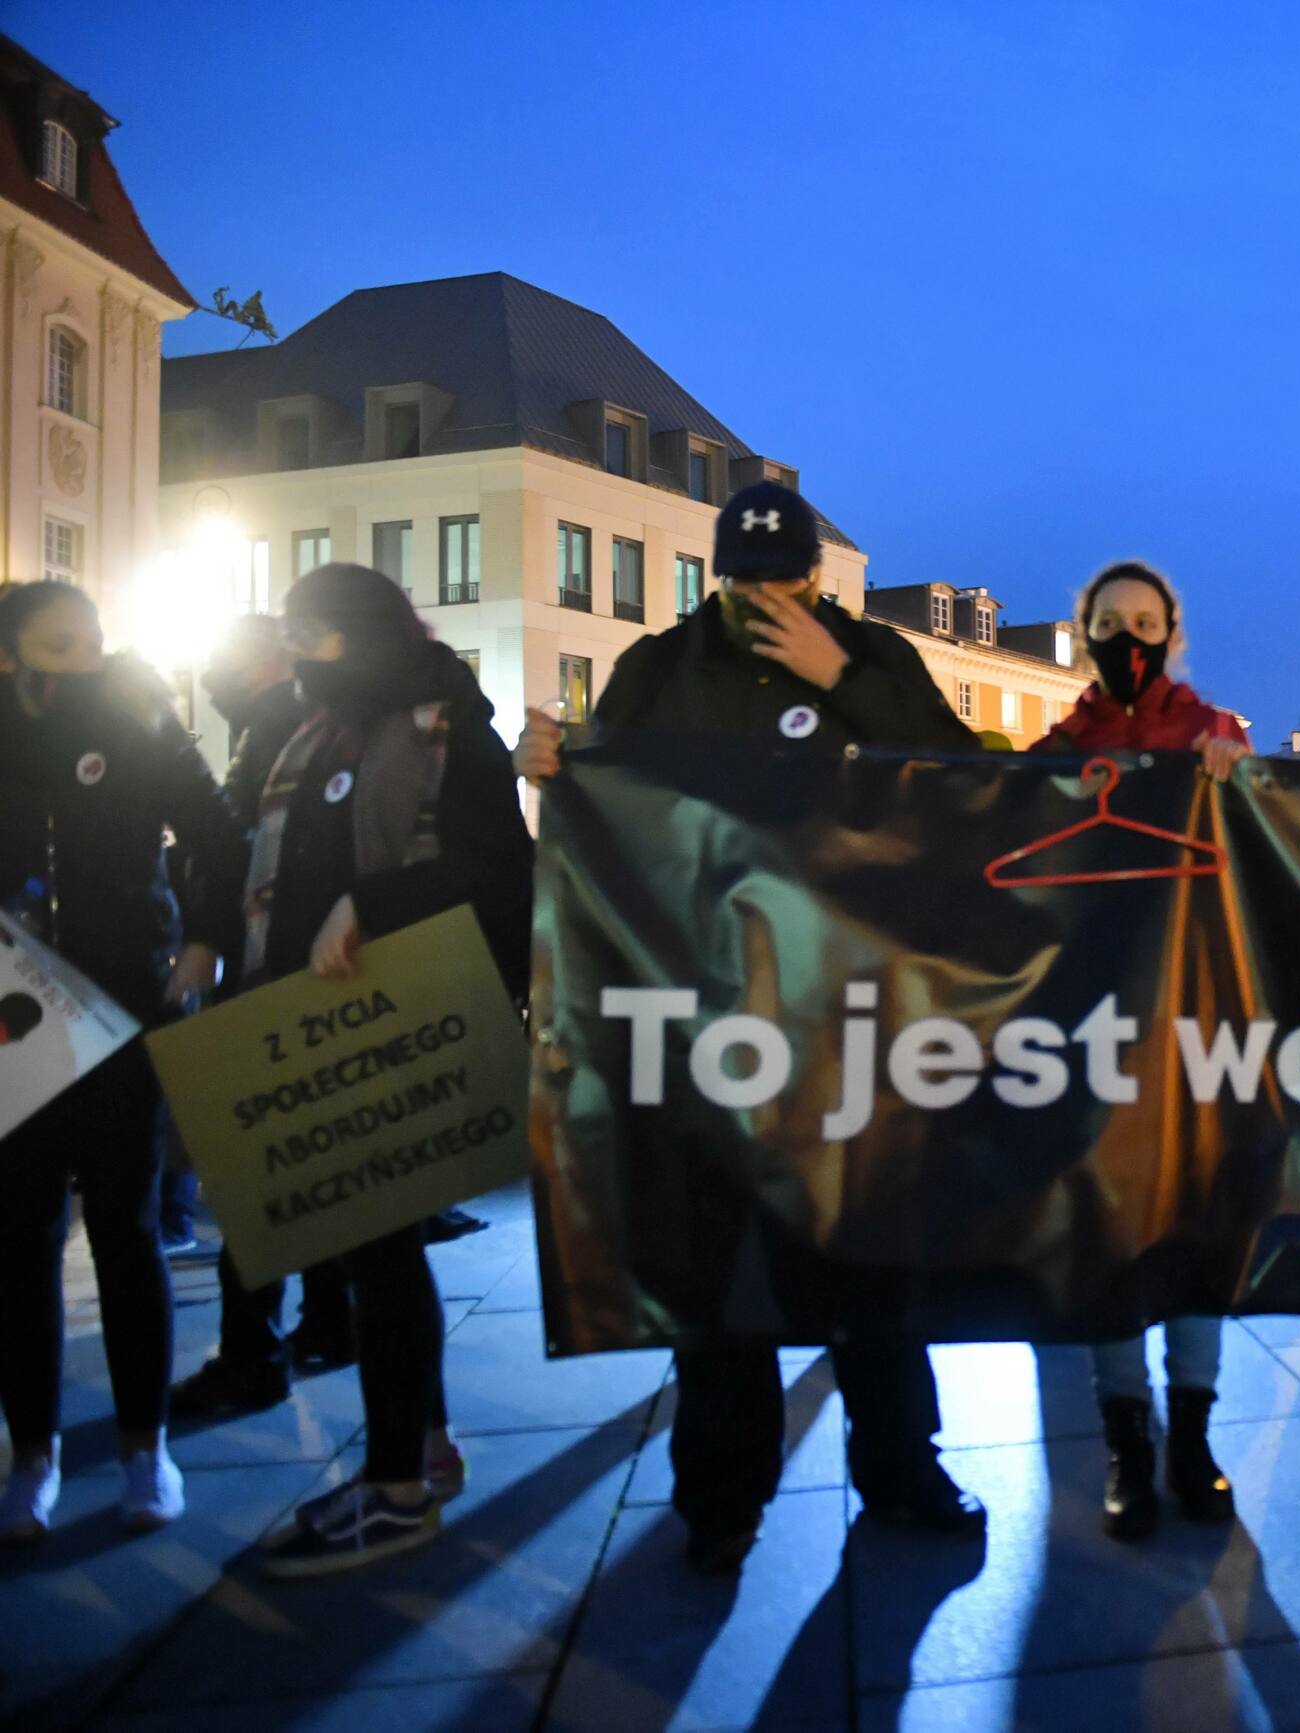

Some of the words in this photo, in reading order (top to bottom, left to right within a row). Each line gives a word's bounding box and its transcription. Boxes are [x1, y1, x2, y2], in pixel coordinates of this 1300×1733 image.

[233, 1013, 467, 1131] SPOŁECZNEGO
[264, 1031, 288, 1064] Z
[601, 987, 793, 1110] To
[821, 980, 1139, 1142] jest
[264, 1065, 468, 1175] ABORDUJMY
[264, 1105, 514, 1228] KACZYŃSKIEGO
